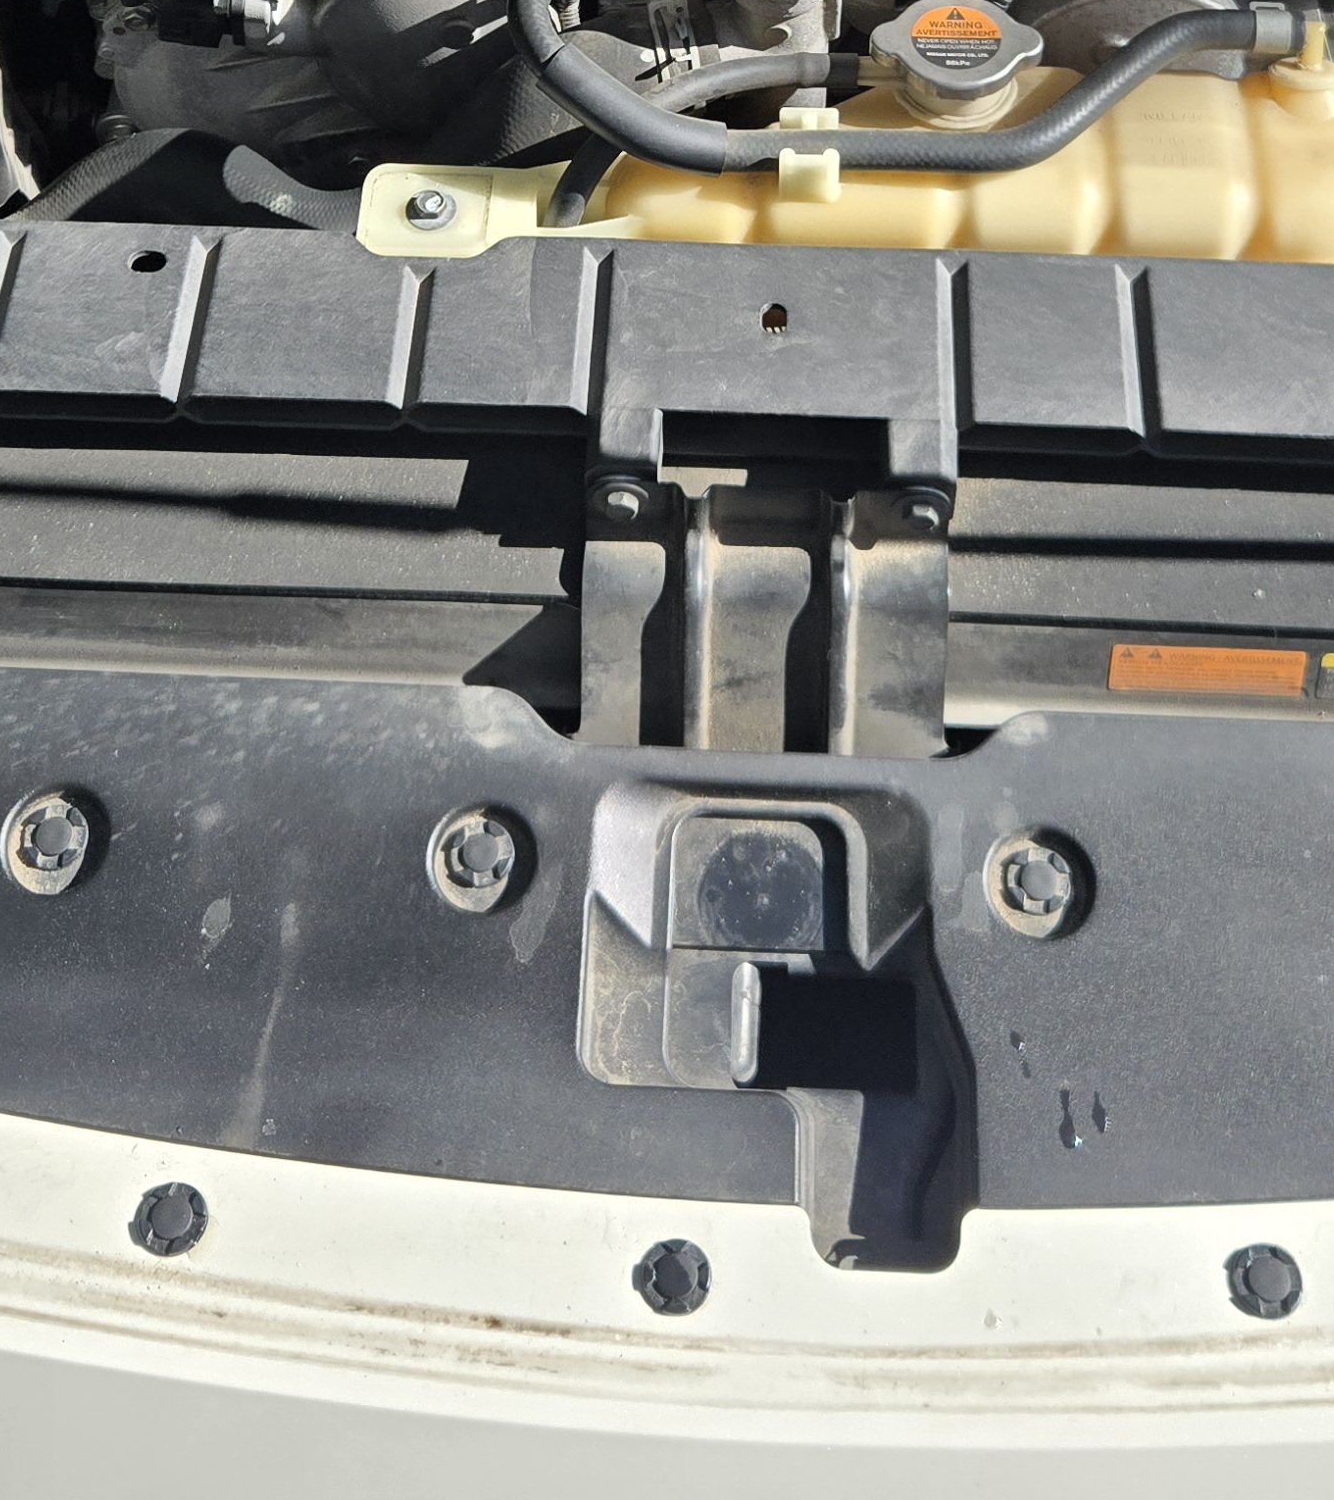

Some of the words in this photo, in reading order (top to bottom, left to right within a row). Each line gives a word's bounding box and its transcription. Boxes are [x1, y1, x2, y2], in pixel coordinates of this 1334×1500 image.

[929, 21, 983, 29] WARNING
[916, 29, 998, 37] AVERTISSEMENT
[1168, 651, 1217, 662] WARNING
[1224, 653, 1300, 664] AVERTISSEMENT
